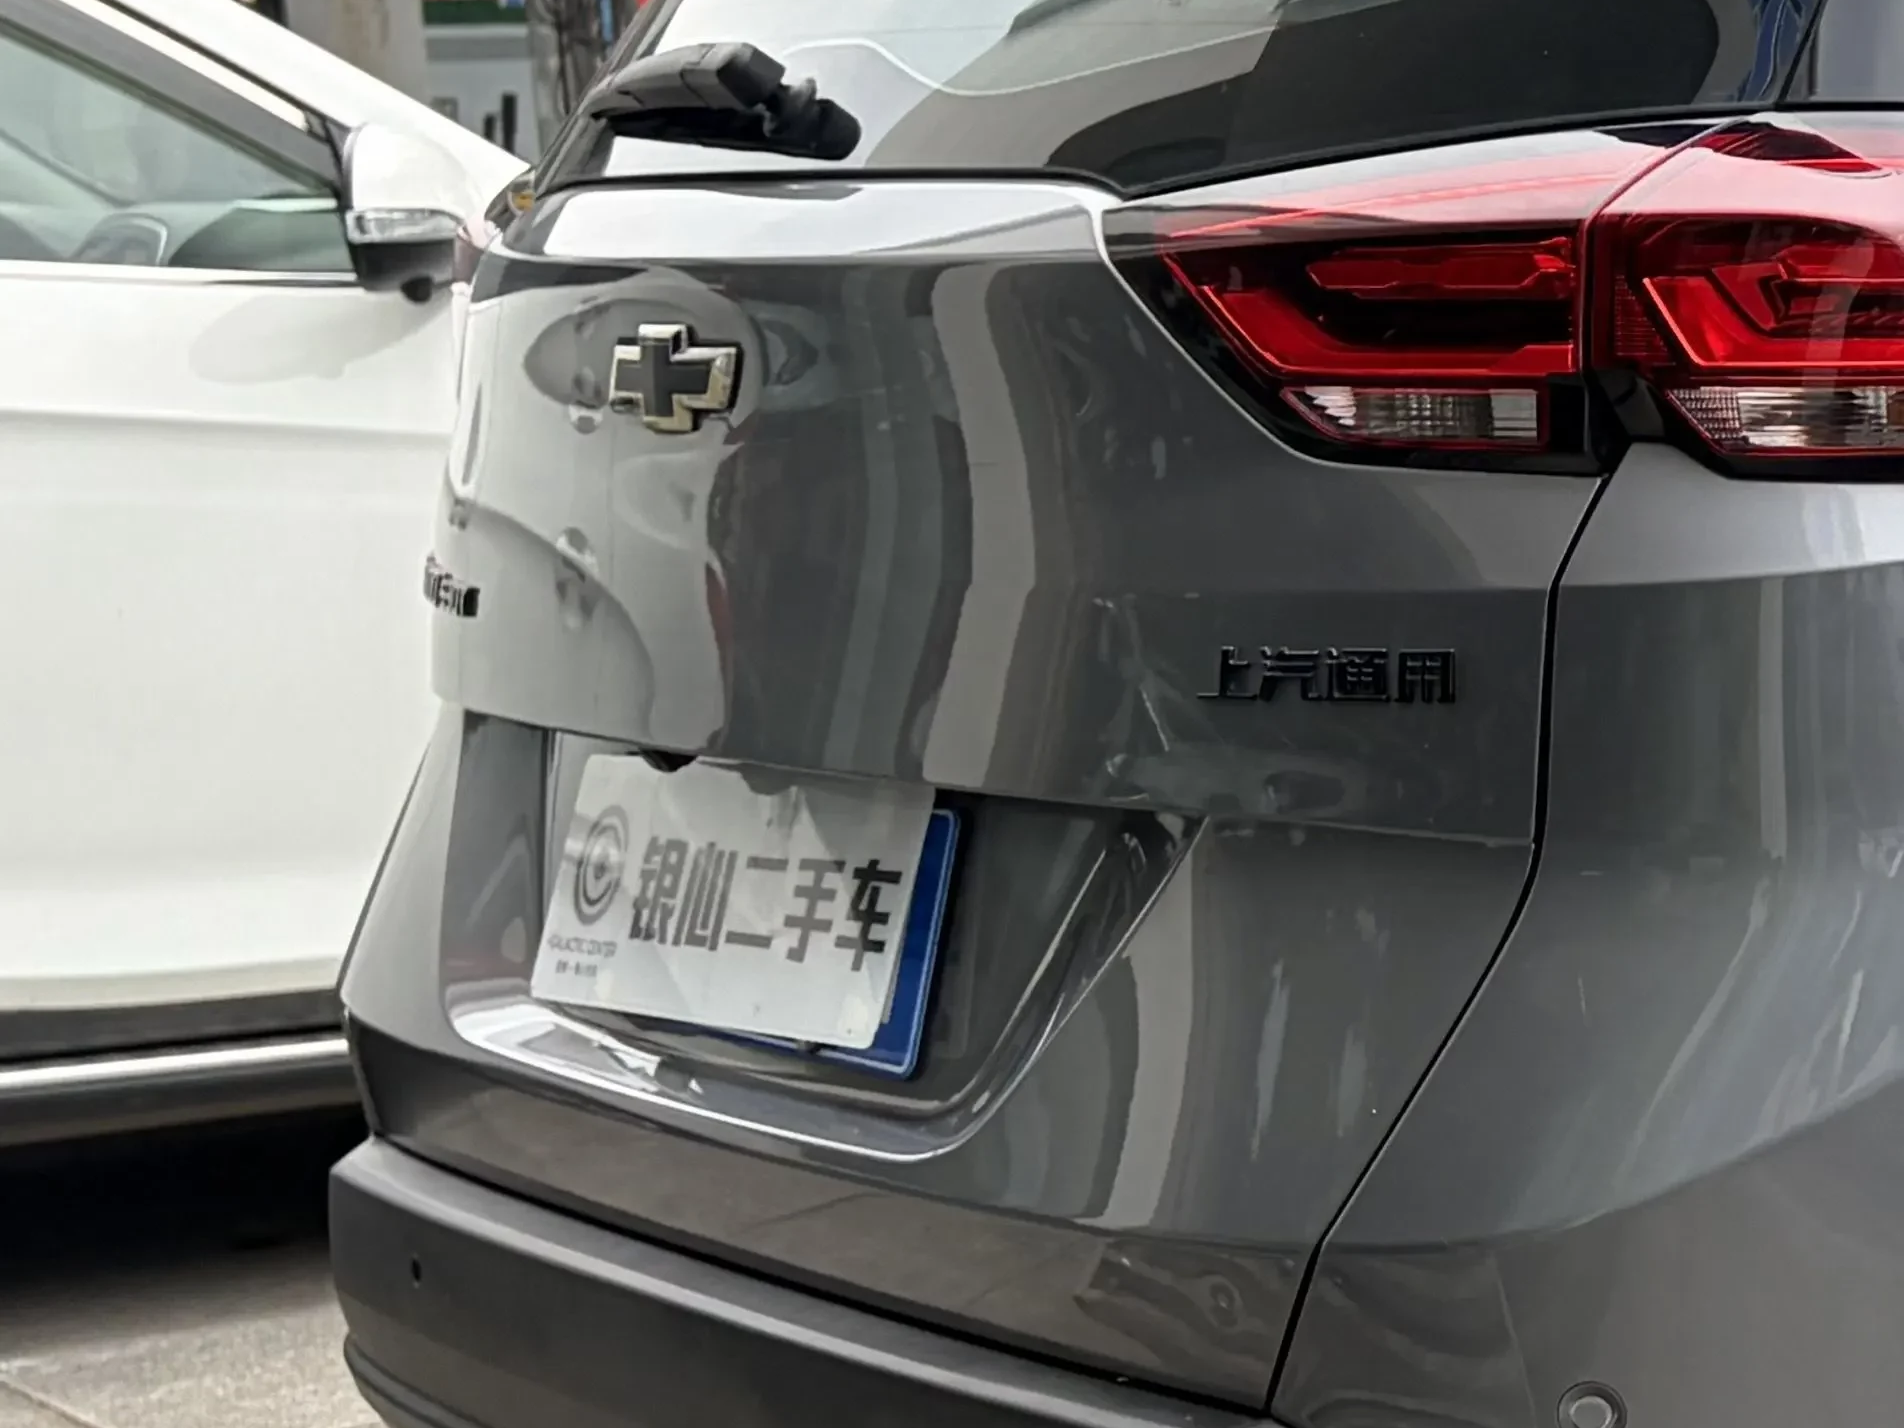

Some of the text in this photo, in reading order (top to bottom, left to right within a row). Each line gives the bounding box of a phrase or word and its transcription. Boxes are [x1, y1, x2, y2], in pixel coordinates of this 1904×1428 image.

[1196, 645, 1456, 704] 上汽通用
[627, 835, 903, 972] 银心二手车
